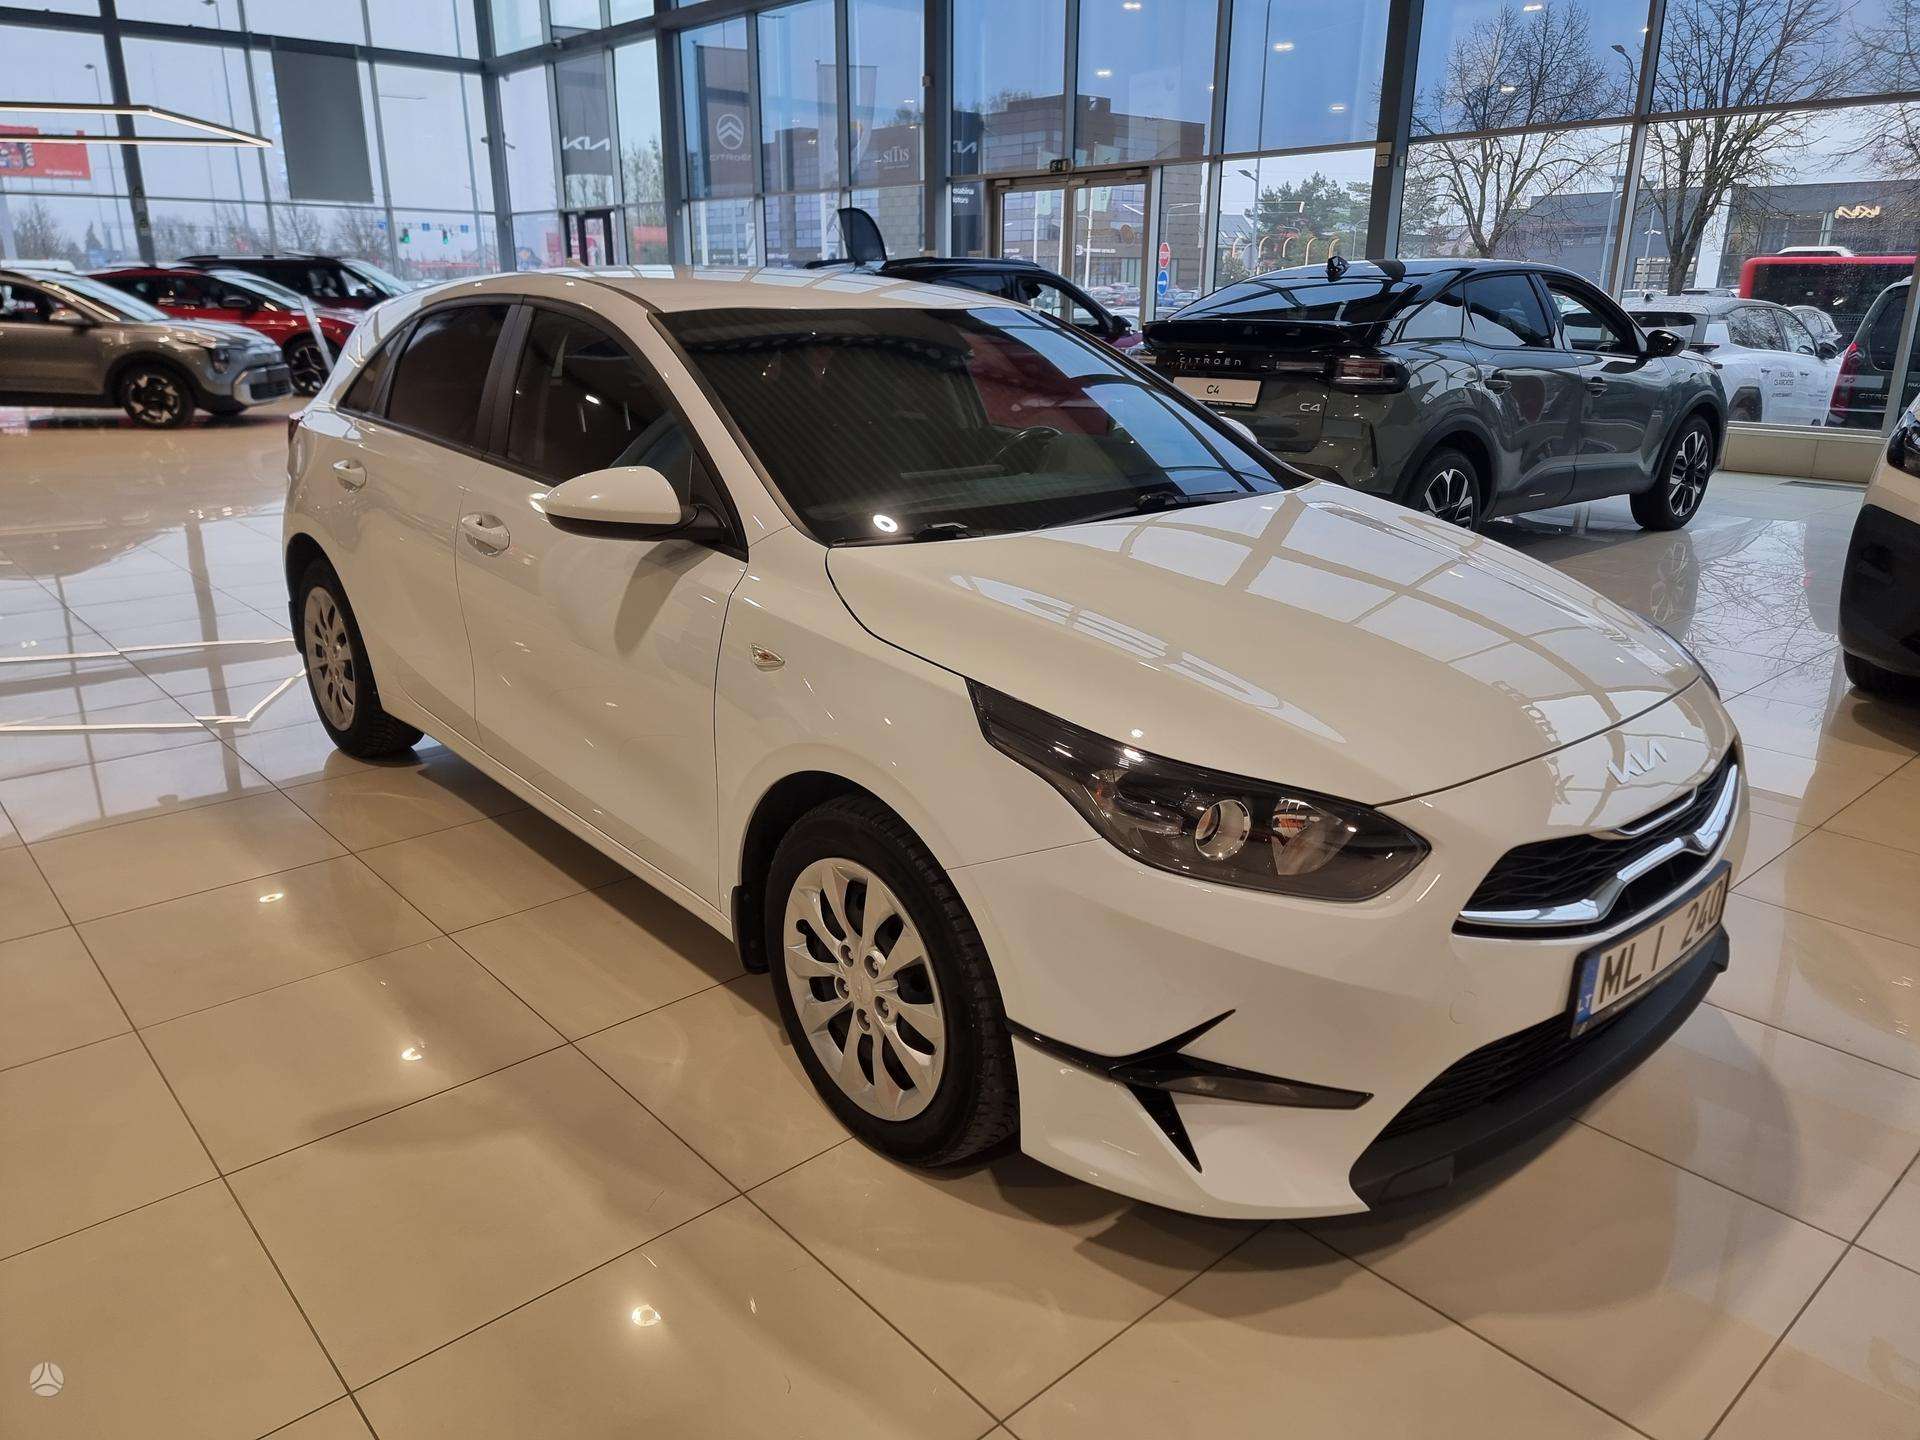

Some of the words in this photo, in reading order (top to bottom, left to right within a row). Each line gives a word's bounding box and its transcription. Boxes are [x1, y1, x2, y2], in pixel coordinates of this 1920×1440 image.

[562, 136, 611, 151] KIA
[1206, 384, 1220, 395] C4
[1299, 403, 1321, 412] C4
[1606, 739, 1668, 784] KIA
